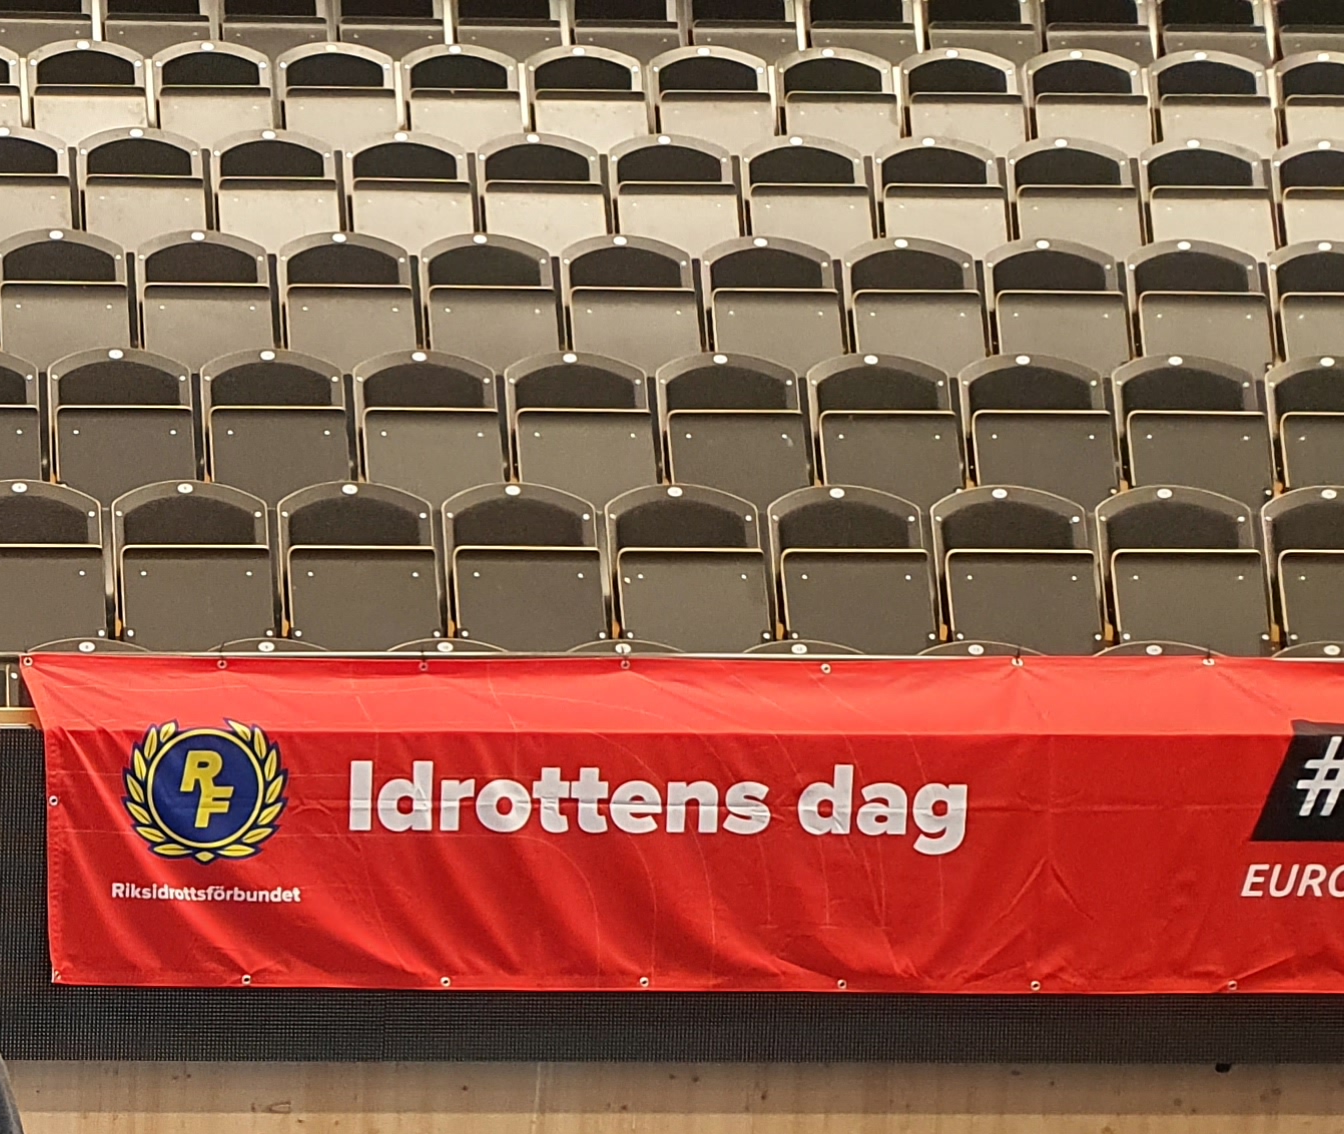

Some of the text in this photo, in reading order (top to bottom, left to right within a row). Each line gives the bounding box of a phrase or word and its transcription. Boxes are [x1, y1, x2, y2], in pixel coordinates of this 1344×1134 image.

[348, 760, 968, 856] Idrottens dag
[111, 883, 301, 902] Riksidrottsförbundet
